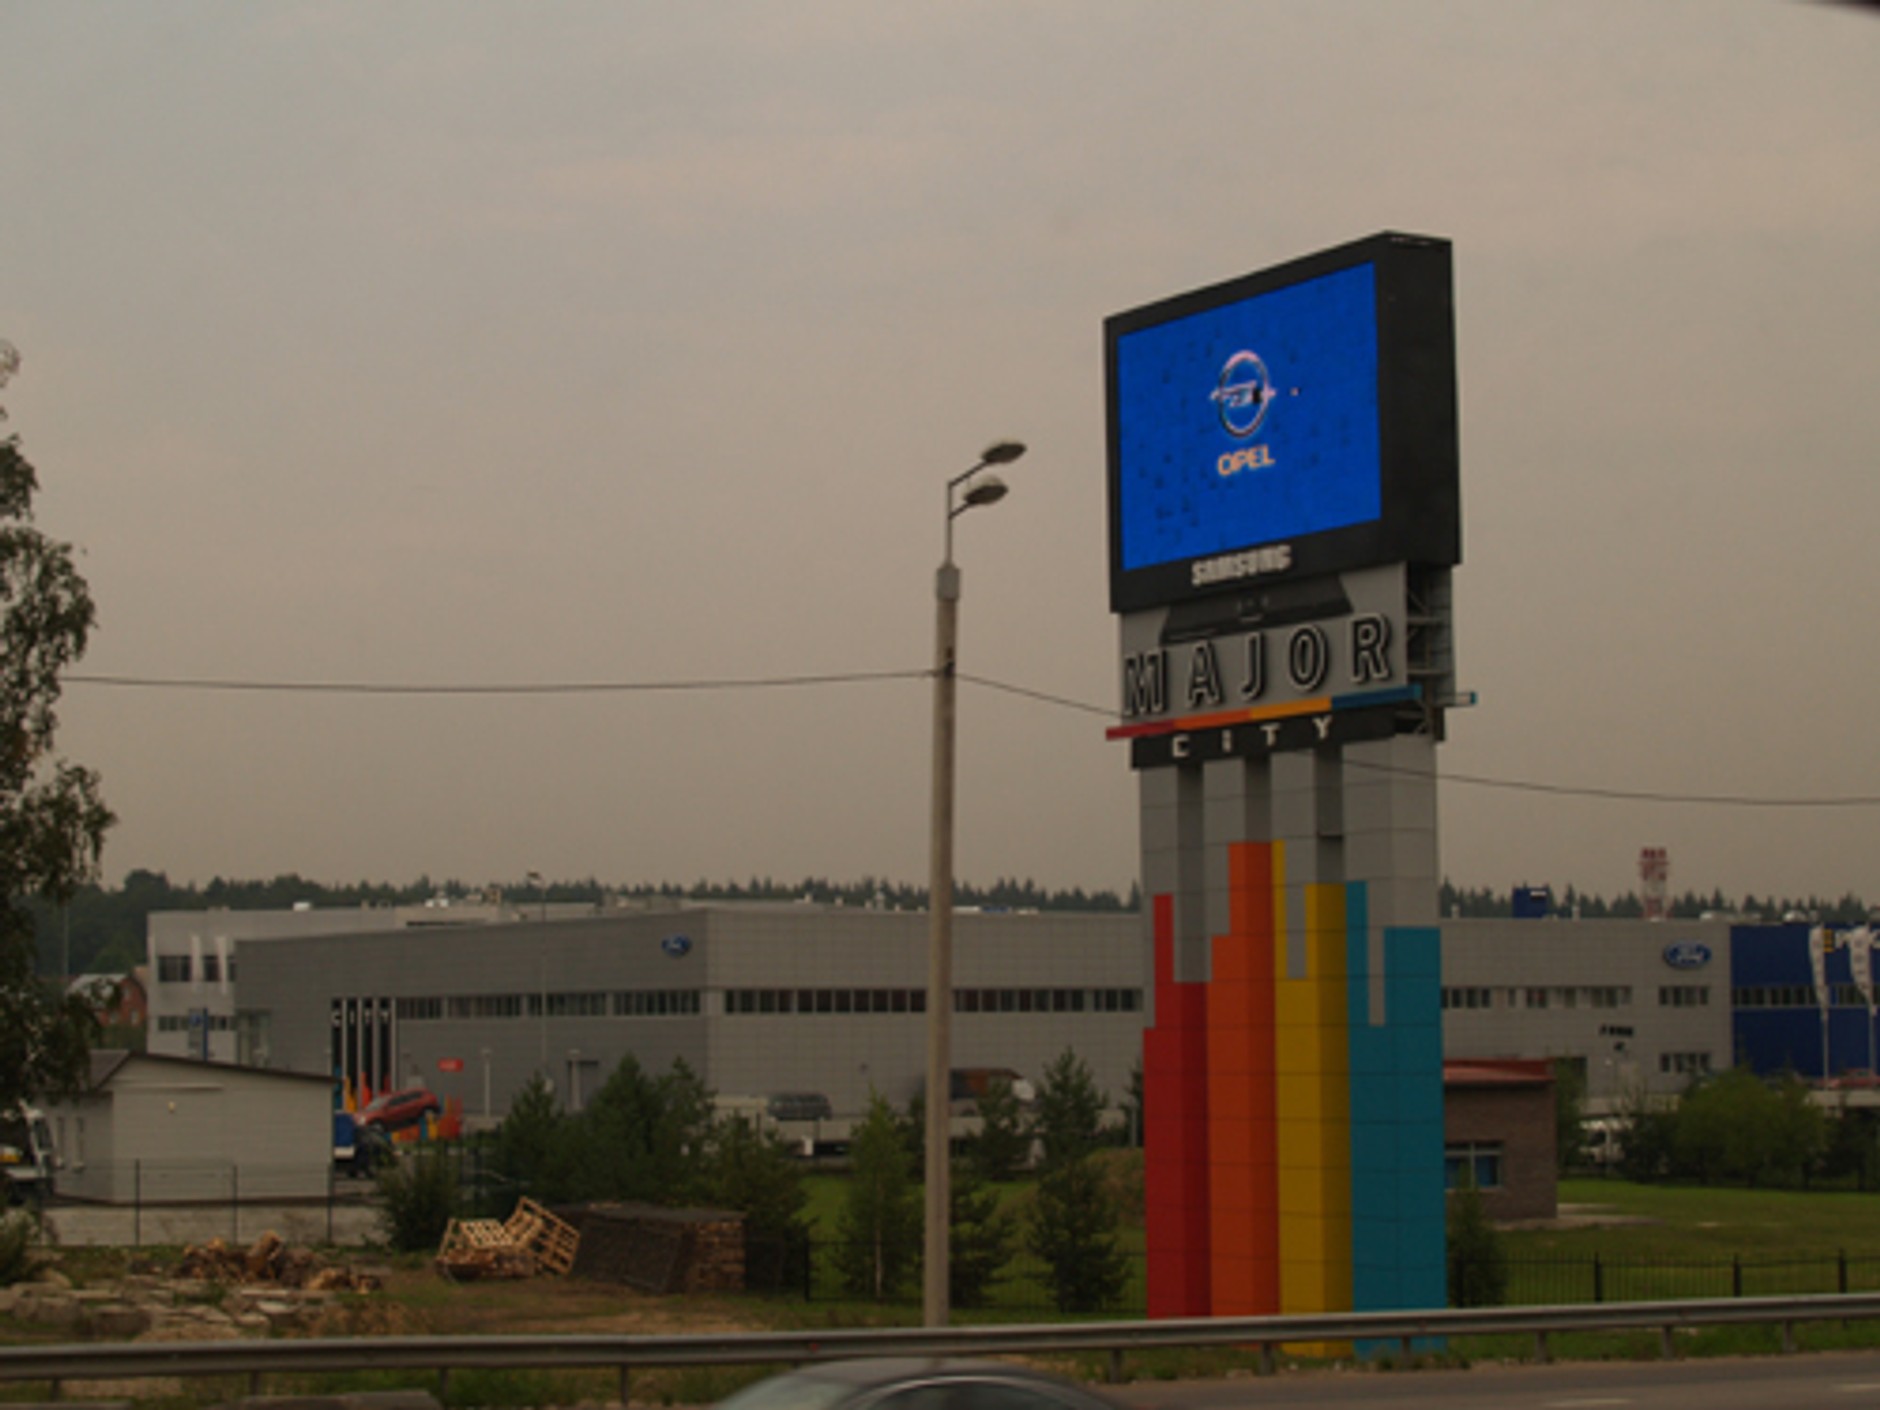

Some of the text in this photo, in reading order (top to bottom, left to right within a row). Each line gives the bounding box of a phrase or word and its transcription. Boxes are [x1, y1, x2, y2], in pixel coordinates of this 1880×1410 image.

[1218, 445, 1274, 475] OPEL
[1192, 545, 1290, 586] SAMSUNG
[1124, 612, 1391, 717] MAJOR
[1173, 717, 1330, 757] CITY
